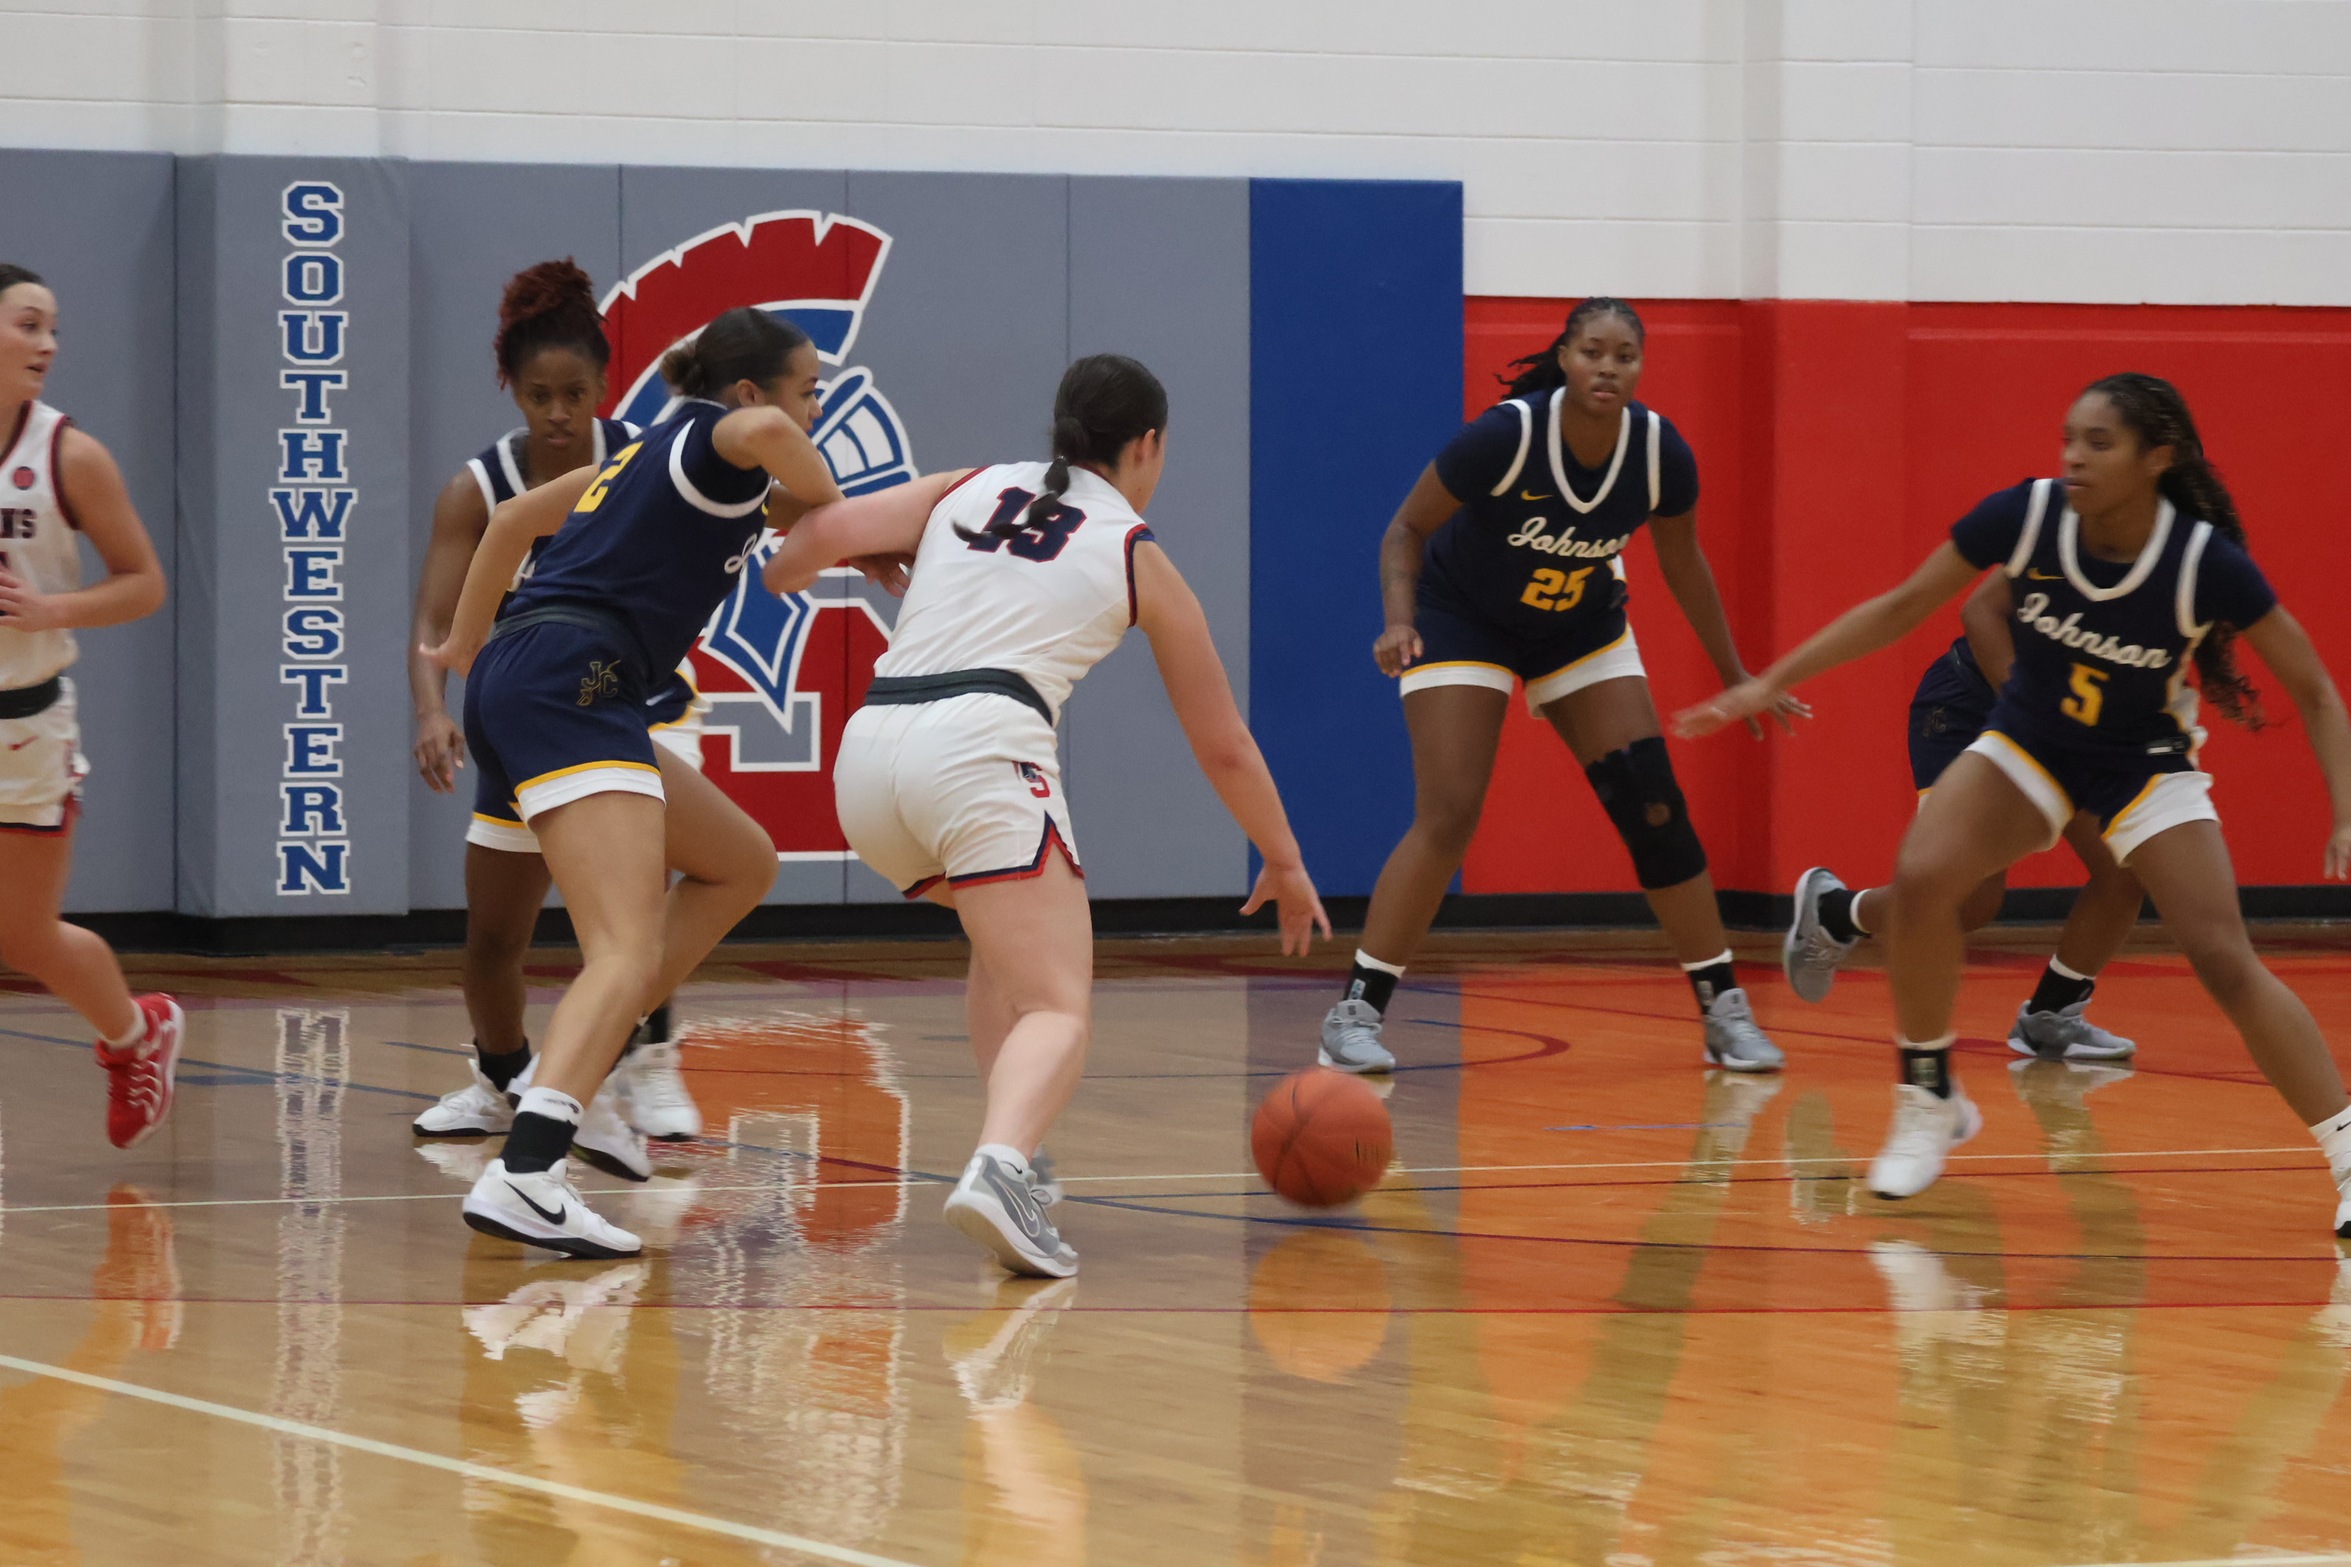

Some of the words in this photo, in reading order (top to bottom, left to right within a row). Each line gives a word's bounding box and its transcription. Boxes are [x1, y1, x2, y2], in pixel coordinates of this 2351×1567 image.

[573, 440, 645, 513] 2
[268, 181, 358, 896] SOUTHWESTERN
[966, 486, 1088, 563] 13
[1520, 566, 1596, 612] 25
[2017, 592, 2172, 669] Johnson
[2060, 661, 2111, 727] 5
